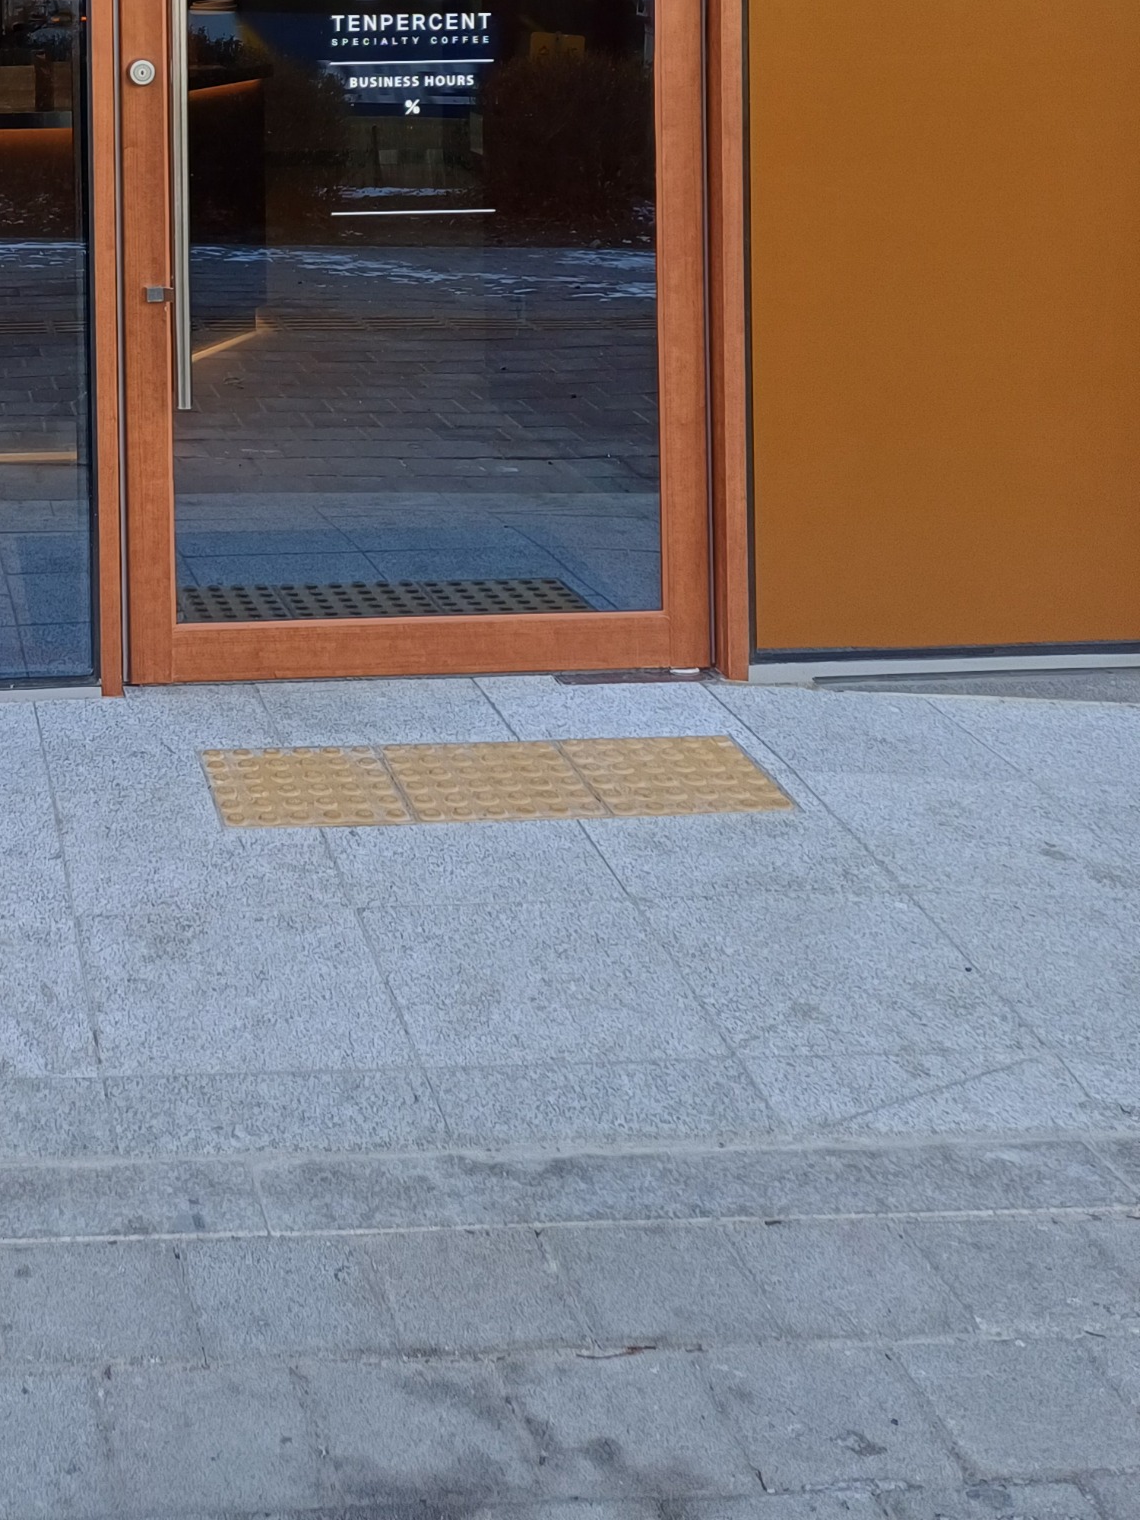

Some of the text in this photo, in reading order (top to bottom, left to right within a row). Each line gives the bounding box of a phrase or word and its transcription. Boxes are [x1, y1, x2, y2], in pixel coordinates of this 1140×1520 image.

[332, 12, 492, 32] TENPERCENT
[332, 35, 490, 47] SPECIALTY COFFEE
[350, 74, 474, 88] BUSINESS HOURS
